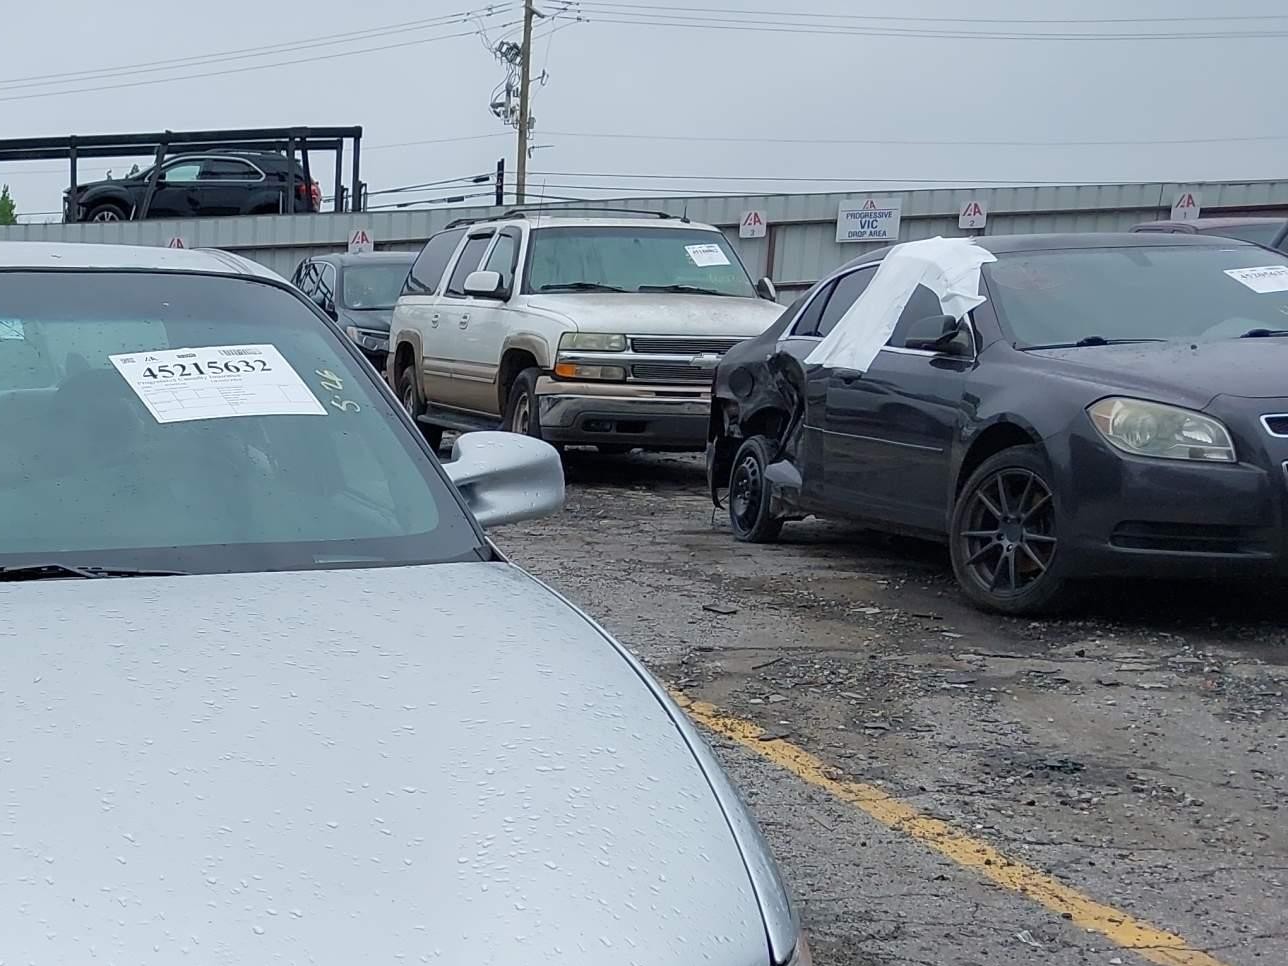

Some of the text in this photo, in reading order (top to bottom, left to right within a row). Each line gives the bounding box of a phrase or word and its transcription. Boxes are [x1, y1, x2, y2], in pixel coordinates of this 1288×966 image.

[846, 211, 893, 220] PROGRESSIVE
[859, 219, 879, 230] VIC
[847, 229, 887, 238] DROP AREA
[142, 359, 273, 379] 45215632
